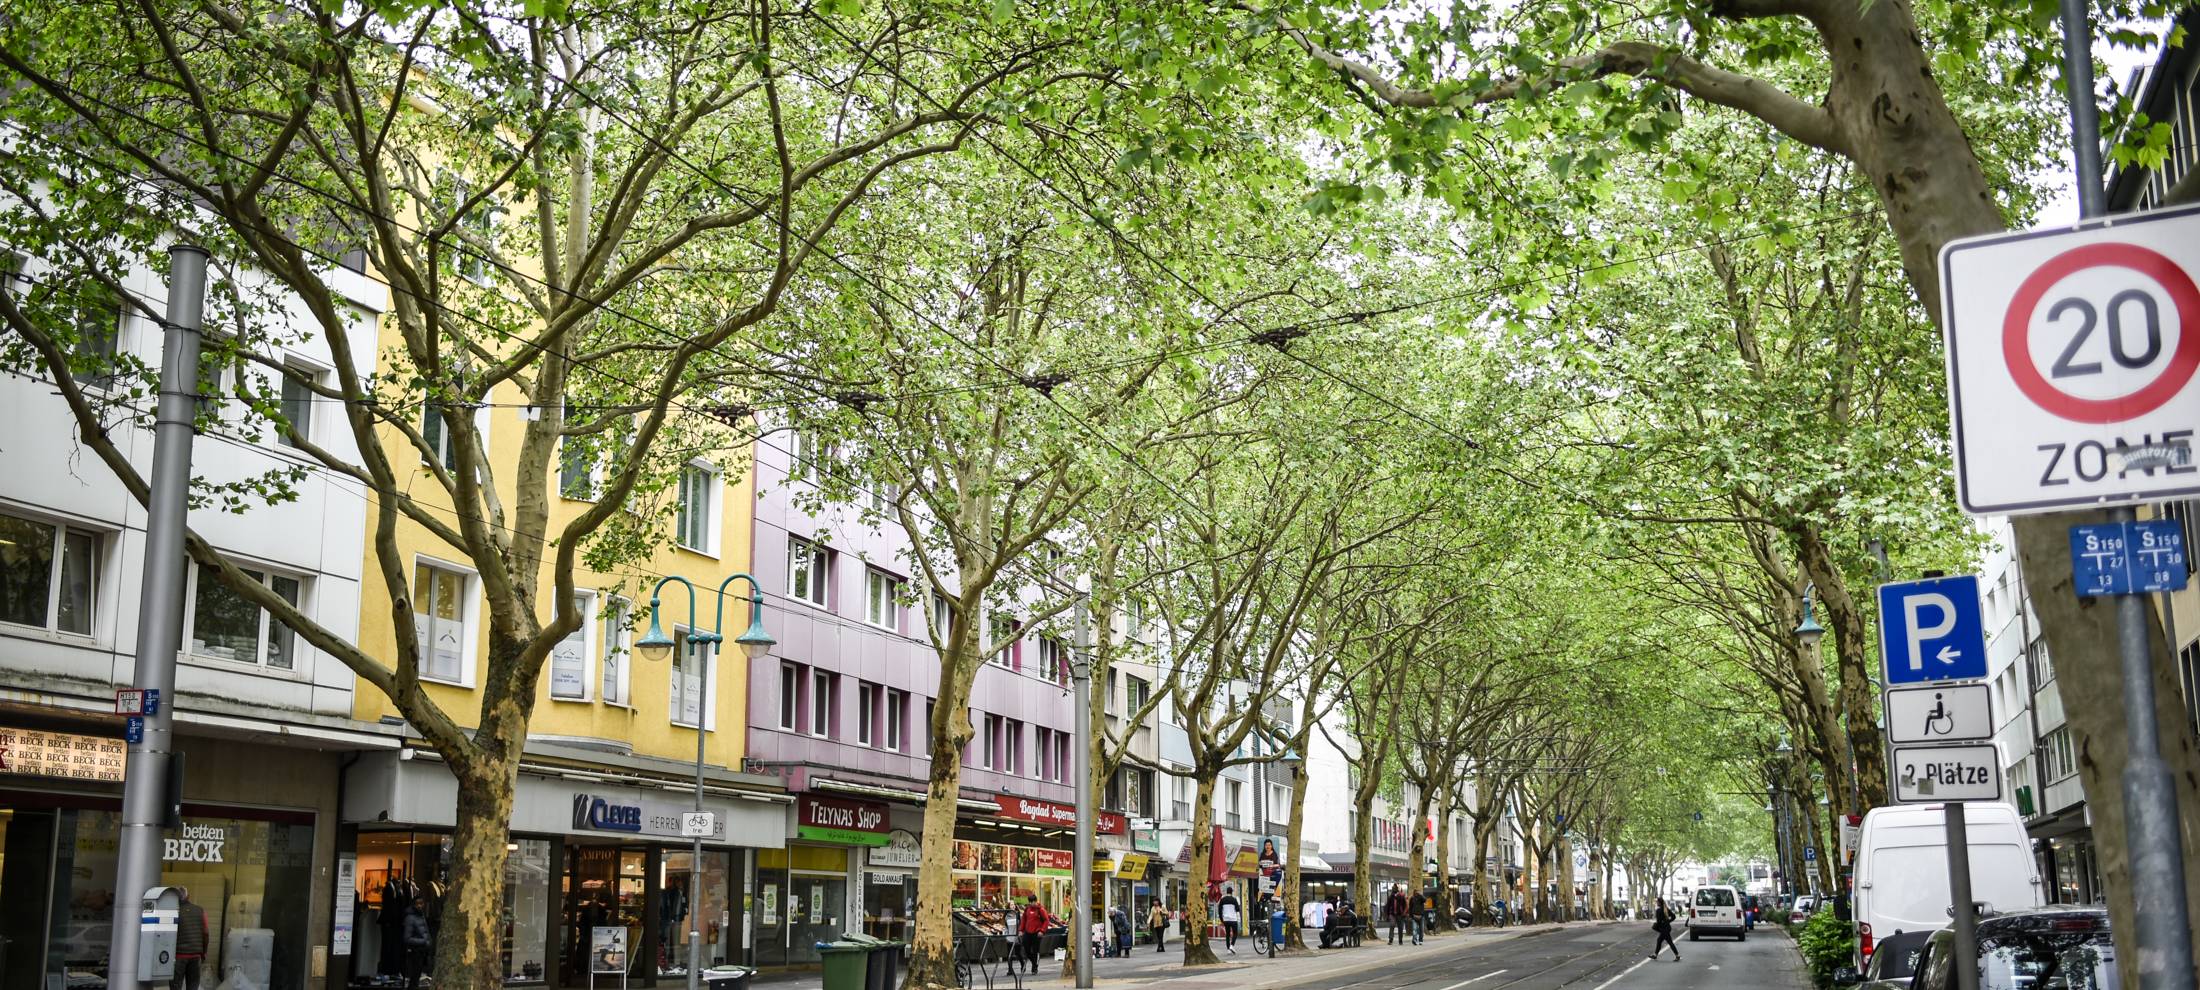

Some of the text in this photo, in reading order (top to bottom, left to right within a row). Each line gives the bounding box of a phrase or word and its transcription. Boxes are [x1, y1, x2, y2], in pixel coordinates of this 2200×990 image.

[2047, 288, 2162, 380] 20
[1903, 593, 1957, 671] P
[20, 736, 44, 747] BECK
[47, 738, 71, 750] BECK
[74, 741, 97, 752] BECK
[100, 744, 123, 754] BECK
[18, 750, 42, 761] BECK
[46, 752, 69, 763] BECK
[73, 755, 96, 765] BECK
[99, 758, 121, 768] BECK
[17, 764, 120, 781] BECK BECK BECK BECK
[1905, 762, 1988, 786] 2 Plätze
[810, 801, 881, 829] TELYNAS SHOP
[1020, 799, 1049, 820] Bagdad
[1052, 806, 1075, 822] Superma
[182, 822, 225, 840] betten
[162, 838, 225, 863] BECK
[1806, 847, 1815, 859] P
